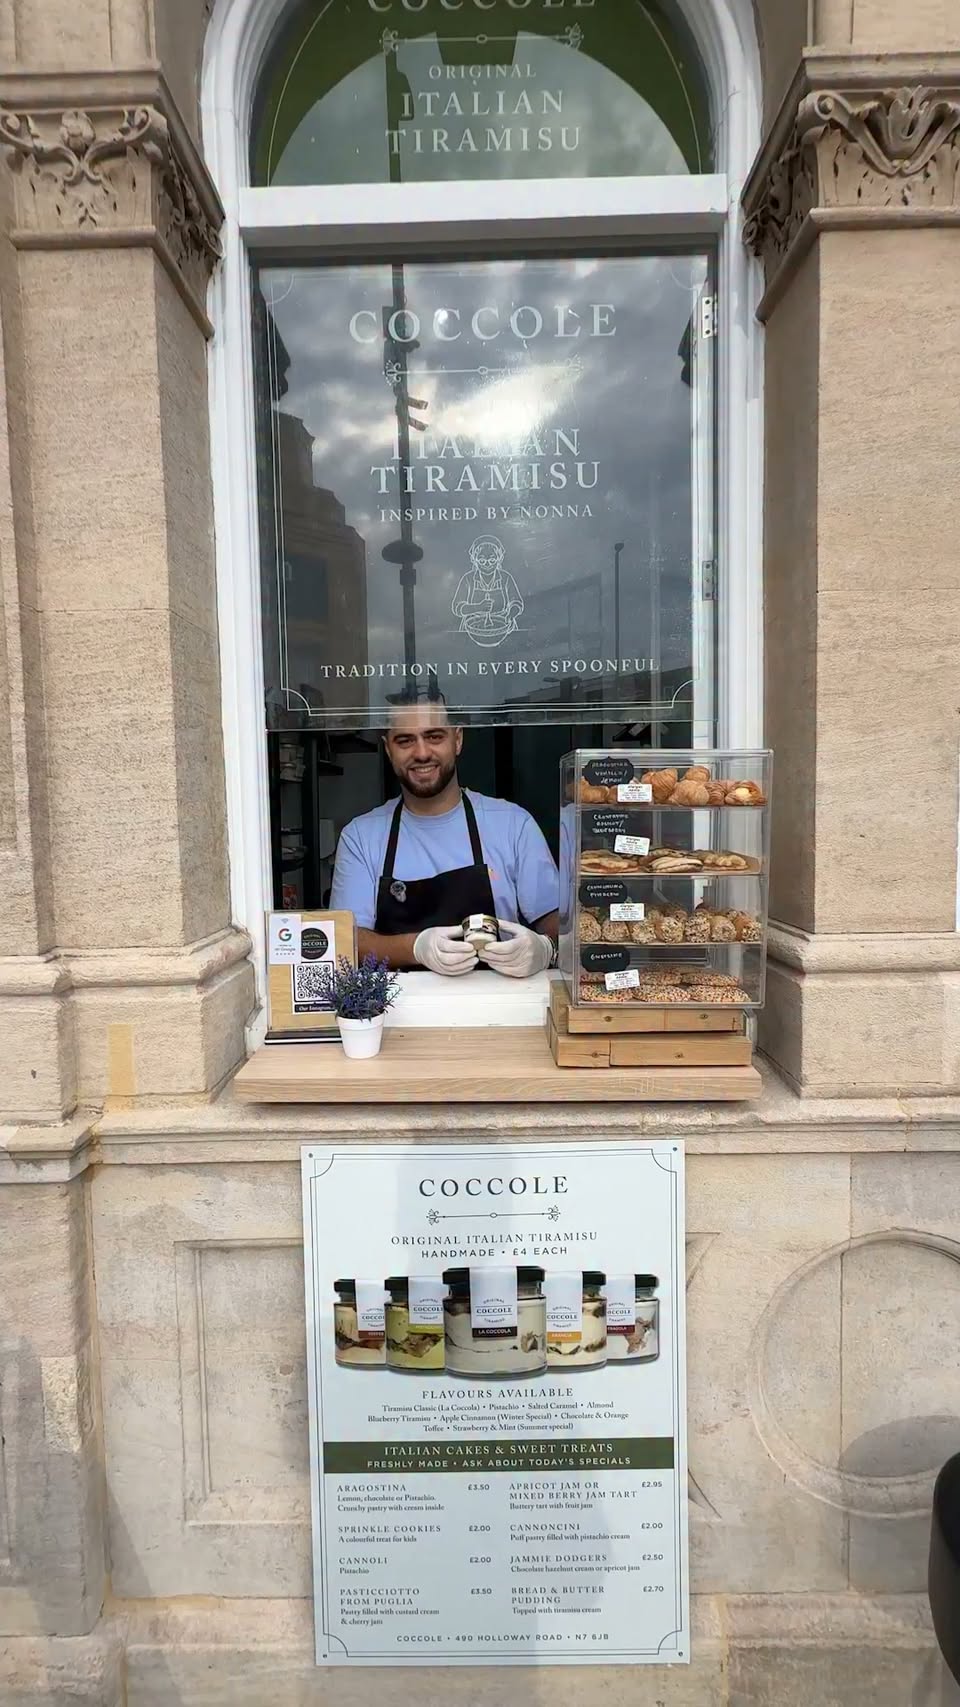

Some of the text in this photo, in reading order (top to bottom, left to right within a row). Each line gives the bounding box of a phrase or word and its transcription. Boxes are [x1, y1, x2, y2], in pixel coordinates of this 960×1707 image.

[429, 64, 537, 80] ORIGINAL
[400, 90, 563, 118] ITALIAN
[385, 127, 582, 154] TIRAMISU
[349, 303, 617, 343] COCCOLE
[370, 461, 600, 494] TIRAMISU
[380, 504, 593, 523] INSPIRED BY NONNA
[320, 658, 660, 679] TRADITION IN EVERY SPOONFUL
[418, 1176, 569, 1197] COCCOLE
[391, 1232, 599, 1245] ORIGINAL ITALIAN TIRAMISU
[421, 1246, 568, 1258] HANDMADE £4 EACH
[422, 1388, 574, 1399] FLAVOURS AVAILABLE
[382, 1404, 412, 1412] Tiramisu
[438, 1403, 449, 1412] (La
[450, 1403, 480, 1411] Coccola)
[367, 1415, 400, 1423] Blueberry
[440, 1414, 459, 1423] Apple
[497, 1413, 524, 1422] (Winter
[525, 1413, 552, 1421] Special)
[604, 1412, 629, 1420] Orange
[423, 1424, 444, 1432] Toffee
[452, 1424, 488, 1432] Strawberry
[517, 1423, 548, 1431] (Summer
[549, 1423, 574, 1431] special)
[384, 1443, 613, 1456] ITALIAN CAKES & SWEET TREATS
[367, 1460, 413, 1468] FRESHLY
[463, 1459, 483, 1467] ASK
[487, 1458, 524, 1466] ABOUT
[529, 1458, 574, 1466] TODAY'S
[579, 1457, 631, 1465] SPECIALS
[337, 1484, 406, 1492] ARAGOSTINA
[509, 1482, 556, 1490] APRICOT
[559, 1482, 580, 1490] JAM
[509, 1490, 637, 1500] MIXED BERRY JAM TART
[337, 1504, 366, 1512] Crunchy
[509, 1503, 534, 1511] Buttery
[581, 1502, 593, 1510] jam
[510, 1523, 580, 1531] CANNONCINI
[510, 1533, 524, 1541] Puff
[580, 1533, 609, 1541] pistachio
[339, 1557, 388, 1565] CANNOLI
[510, 1555, 551, 1563] JAMMIE
[555, 1554, 607, 1562] DODGERS
[511, 1565, 544, 1573] Chocolate
[604, 1565, 626, 1573] apricot
[628, 1564, 640, 1572] jam
[340, 1588, 420, 1596] PASTICCIOTTO
[551, 1586, 558, 1594] &
[562, 1586, 605, 1594] BUTTER
[340, 1608, 361, 1616] Pastry
[512, 1607, 536, 1615] Topped
[348, 1618, 369, 1626] cherry
[370, 1618, 383, 1626] jam
